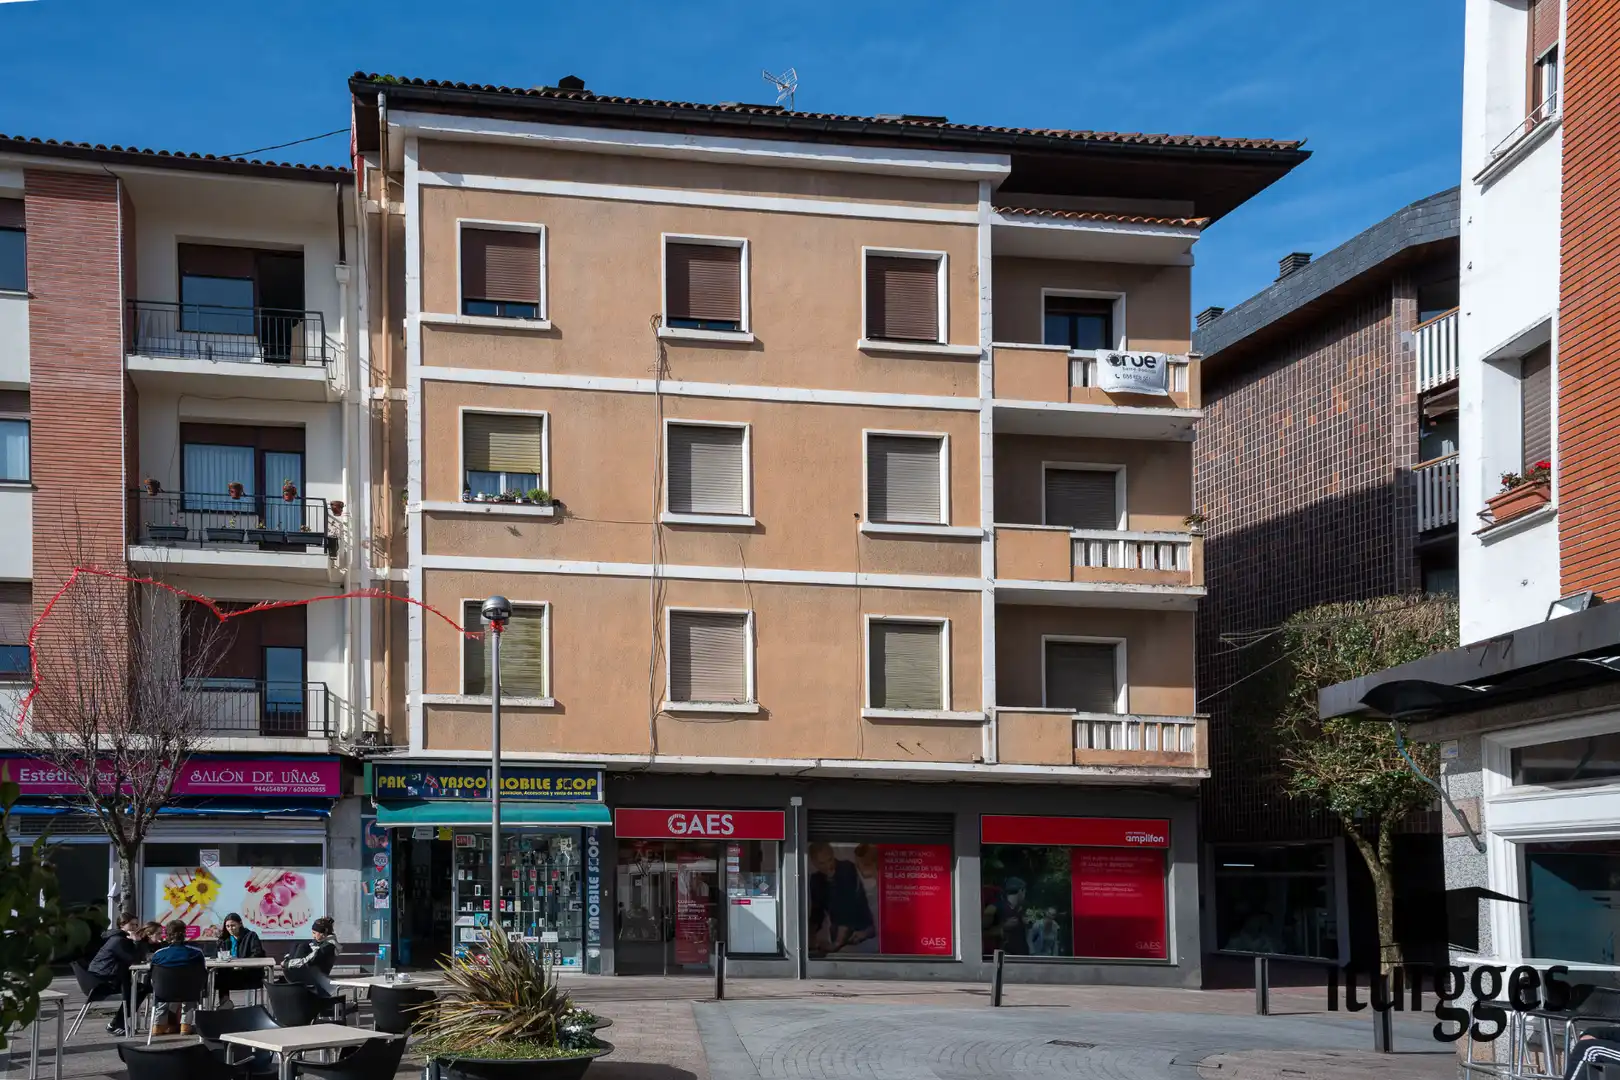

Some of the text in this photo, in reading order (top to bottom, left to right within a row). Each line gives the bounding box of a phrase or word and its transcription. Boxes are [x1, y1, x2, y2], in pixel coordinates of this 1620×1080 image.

[20, 768, 85, 781] Estéti
[190, 768, 320, 783] SALÓN DE UÑAS
[378, 775, 487, 789] PAK VASCO
[667, 813, 735, 835] GAES
[1125, 833, 1164, 844] amplifon
[588, 876, 600, 929] MOBILE
[920, 936, 947, 946] GAES
[1135, 940, 1160, 950] GAES
